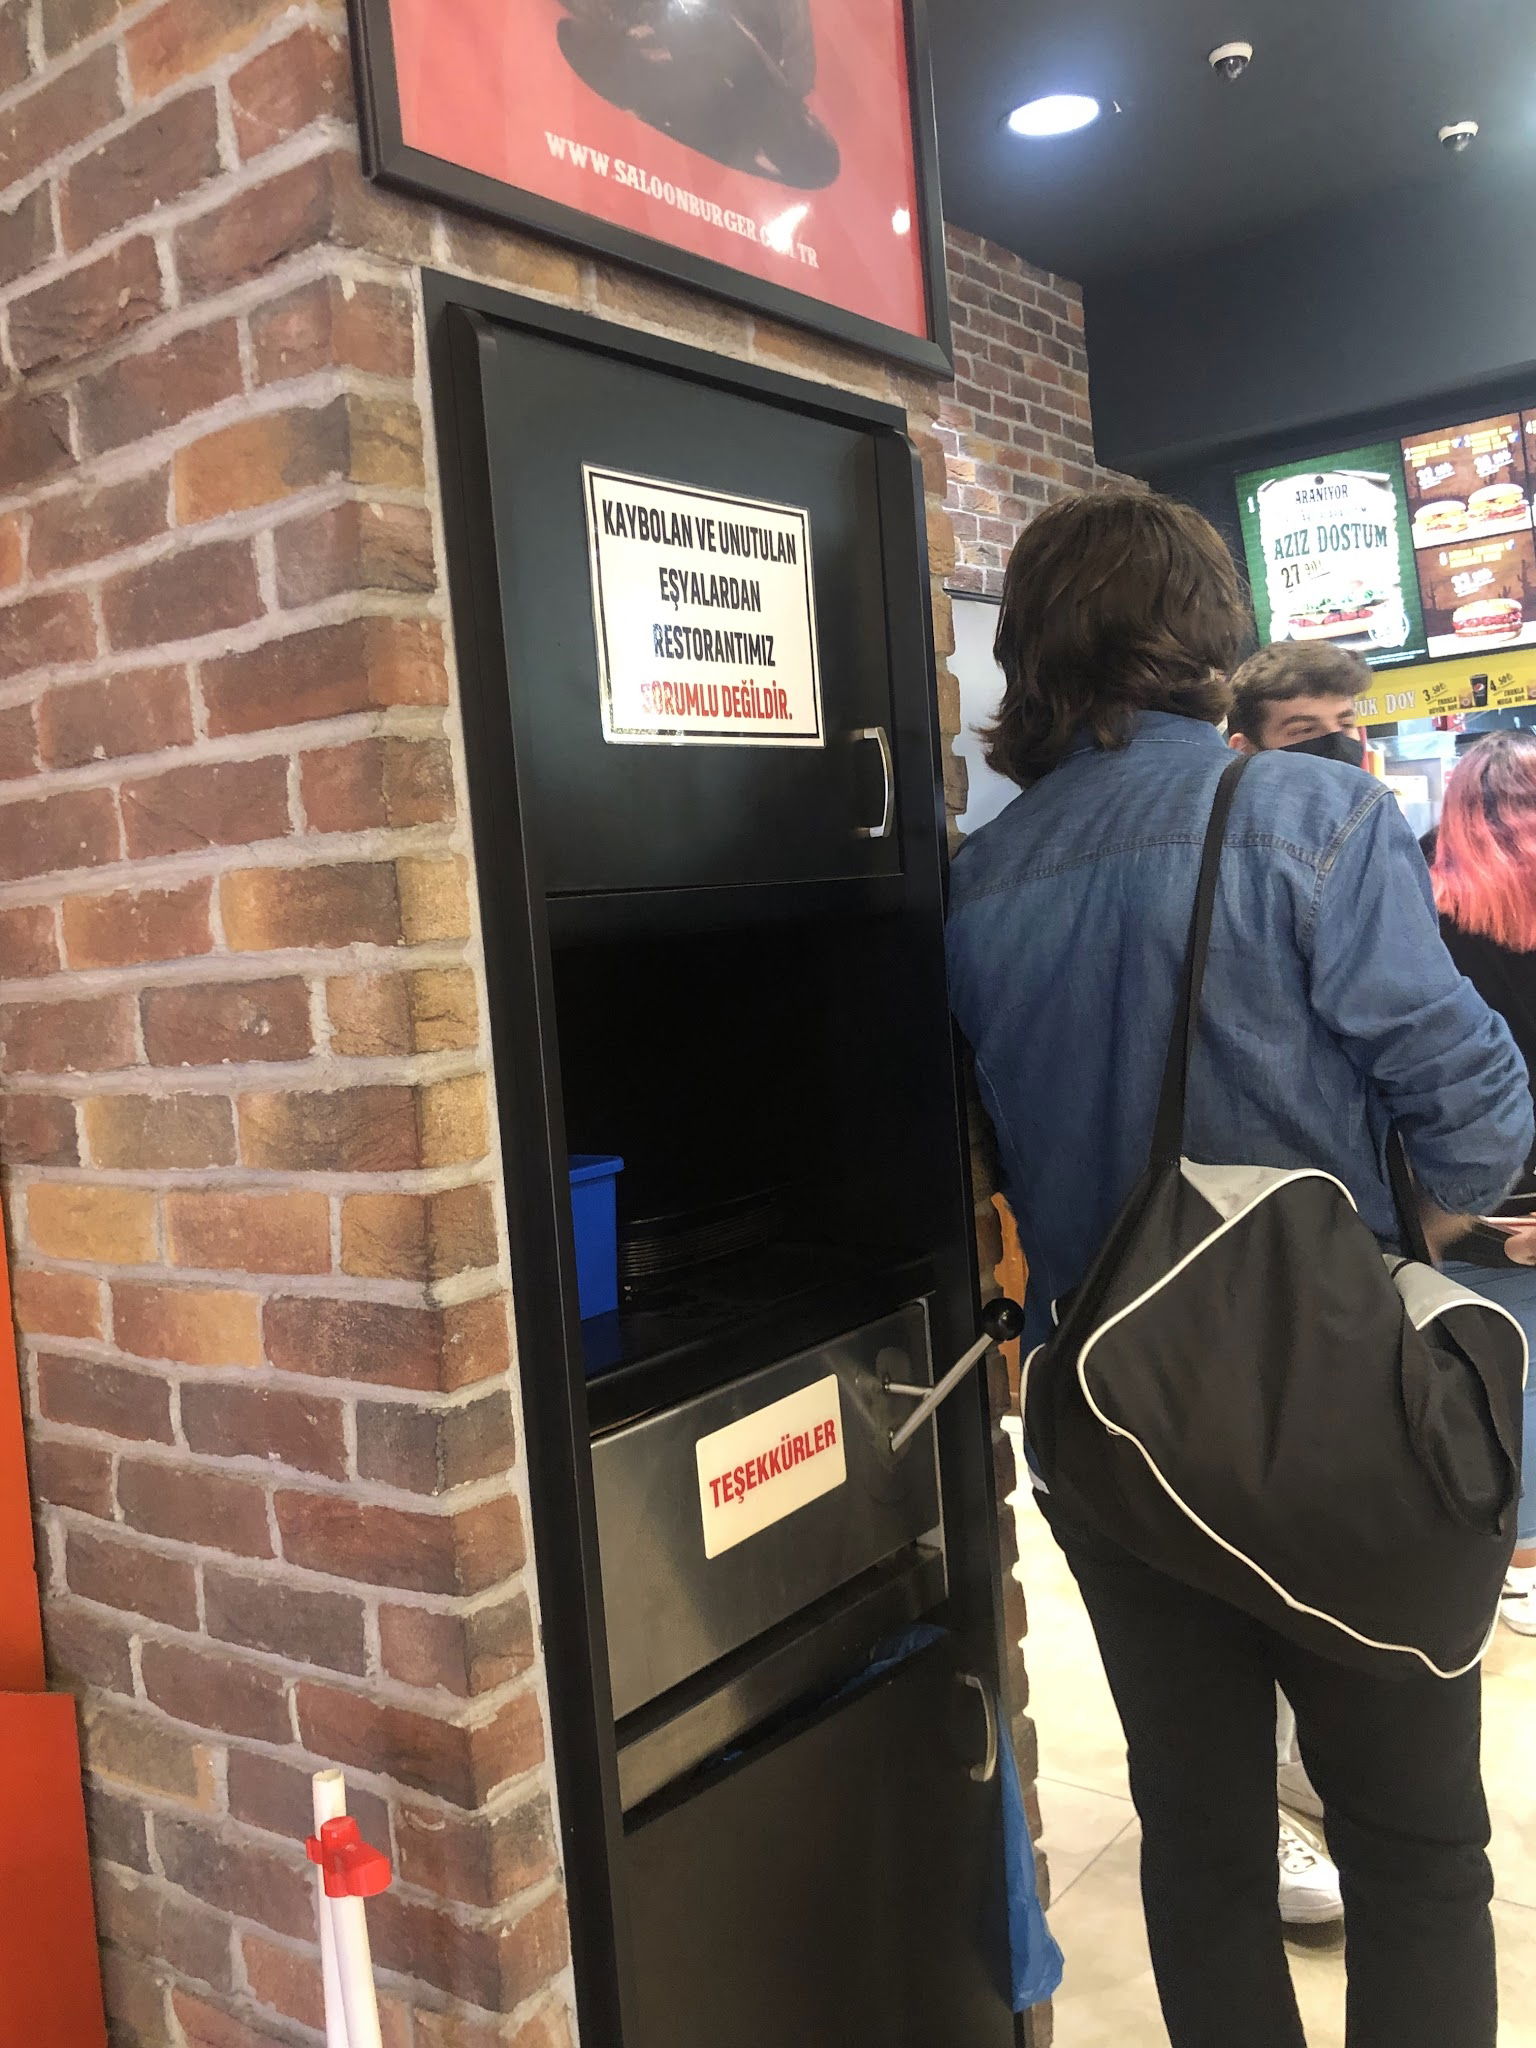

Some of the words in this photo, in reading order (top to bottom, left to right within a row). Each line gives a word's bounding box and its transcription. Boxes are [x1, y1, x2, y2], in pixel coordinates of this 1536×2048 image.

[1295, 484, 1349, 504] ARANIYOR
[602, 498, 694, 549] KAYBOLAN
[695, 516, 717, 552] VE
[718, 521, 797, 565] UNUTULAN
[1317, 523, 1388, 553] DOSTUM
[659, 567, 762, 612] EŞYALARDAN
[652, 623, 776, 667] RESTORANTIMIZ
[640, 680, 719, 718] SORUMLU
[721, 679, 793, 720] DEĞİLDİR.
[1385, 690, 1416, 714] DOY
[709, 1419, 837, 1508] TEŞEKKÜRLER
